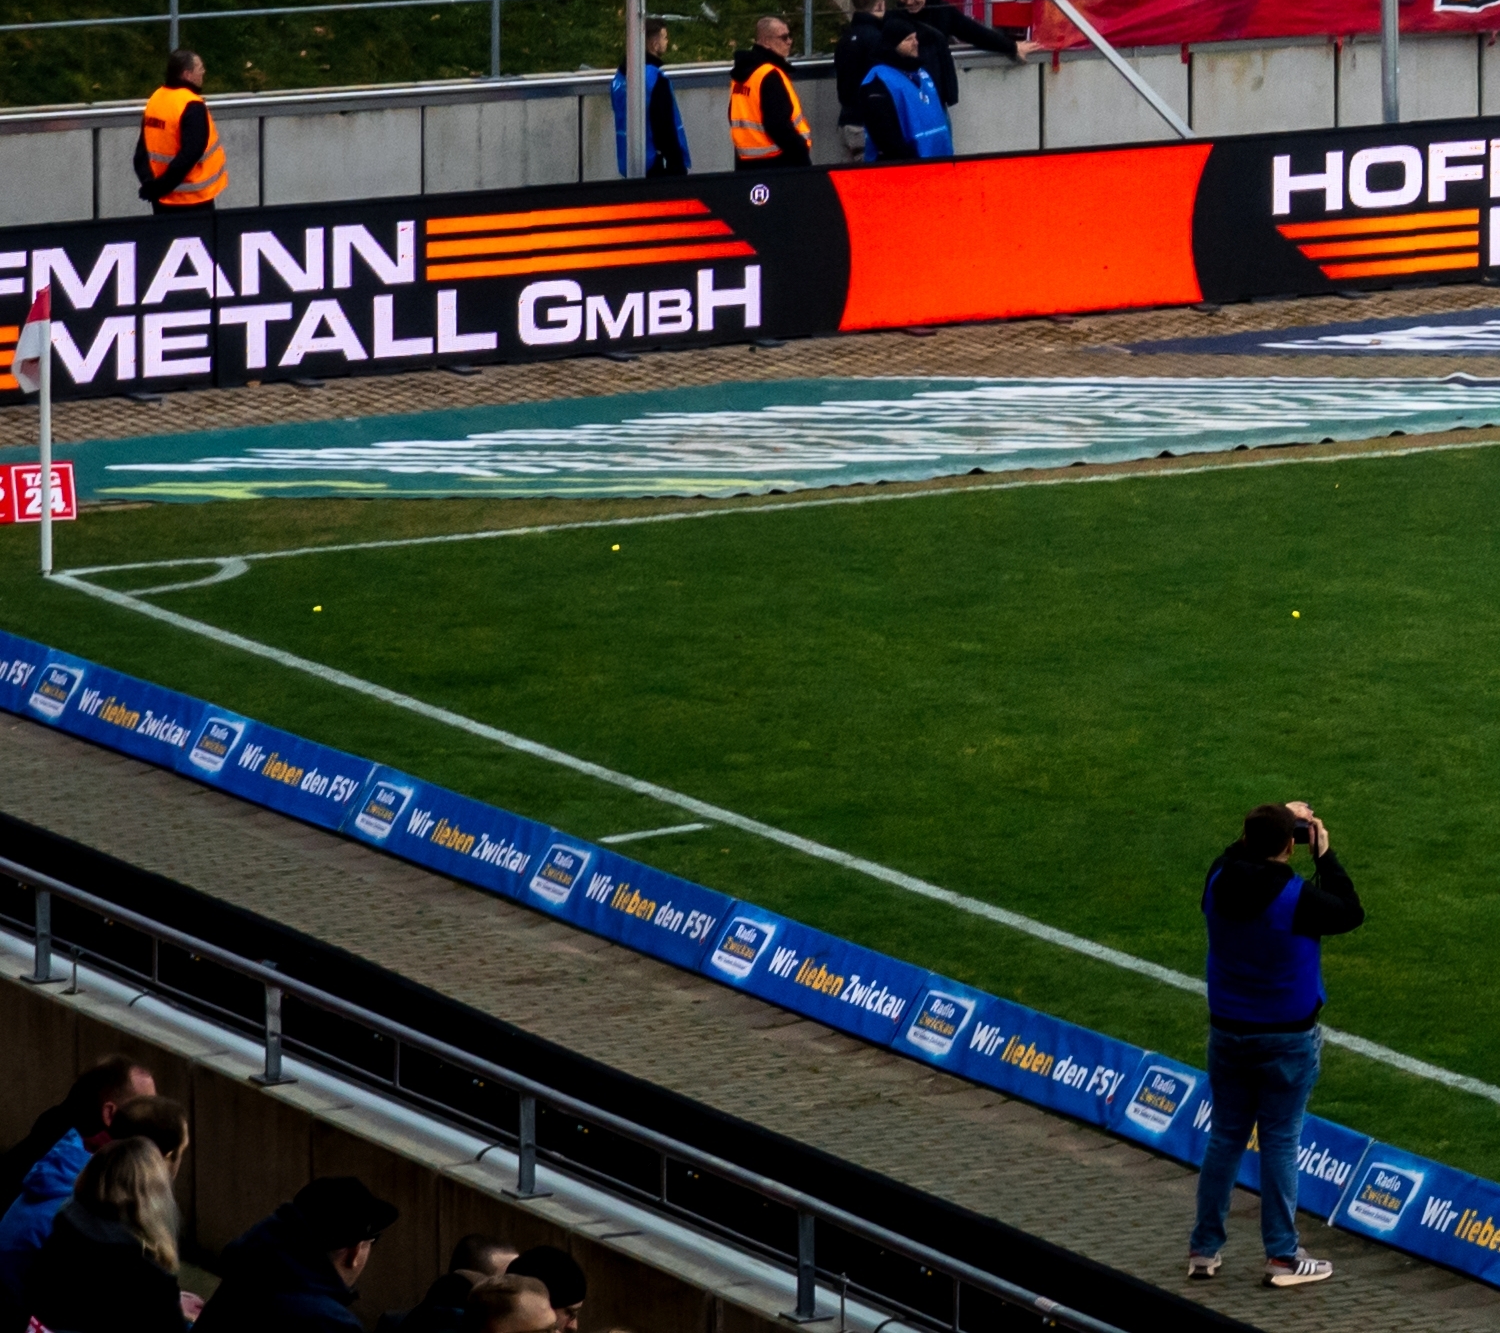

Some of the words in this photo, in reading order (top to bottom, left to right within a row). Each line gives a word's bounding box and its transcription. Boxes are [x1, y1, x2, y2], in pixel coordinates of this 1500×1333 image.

[46, 288, 498, 386] METALL
[24, 486, 67, 515] 24
[6, 659, 36, 689] FSV
[77, 687, 104, 716] Wir
[97, 695, 141, 731] lieben
[136, 709, 192, 750] Zwickau
[237, 742, 267, 772] Wir
[261, 751, 304, 788] lieben
[300, 767, 329, 798] den
[326, 774, 360, 804] FSV
[376, 788, 397, 807] Radio
[406, 807, 435, 839] Wir
[430, 817, 477, 855] lieben
[471, 833, 532, 875] Zwickau
[553, 851, 575, 870] Radio
[585, 871, 615, 904] Wir
[610, 882, 658, 921] lieben
[653, 900, 685, 934] den
[681, 908, 717, 942] FSV
[735, 924, 758, 943] Radio
[767, 945, 799, 979] Wir
[794, 956, 846, 998] lieben
[839, 973, 907, 1021] Zwickau
[929, 998, 956, 1020] Radio
[968, 1020, 1005, 1057] Wir
[1001, 1034, 1055, 1077] lieben
[1051, 1054, 1090, 1091] den
[1085, 1064, 1126, 1099] FSV
[1151, 1072, 1177, 1096] Radio
[1138, 1086, 1177, 1114] Zwickau
[1296, 1141, 1353, 1187] ickau
[1374, 1169, 1402, 1193] Radio
[1361, 1183, 1403, 1212] Zwickau
[1420, 1195, 1459, 1233] Wir
